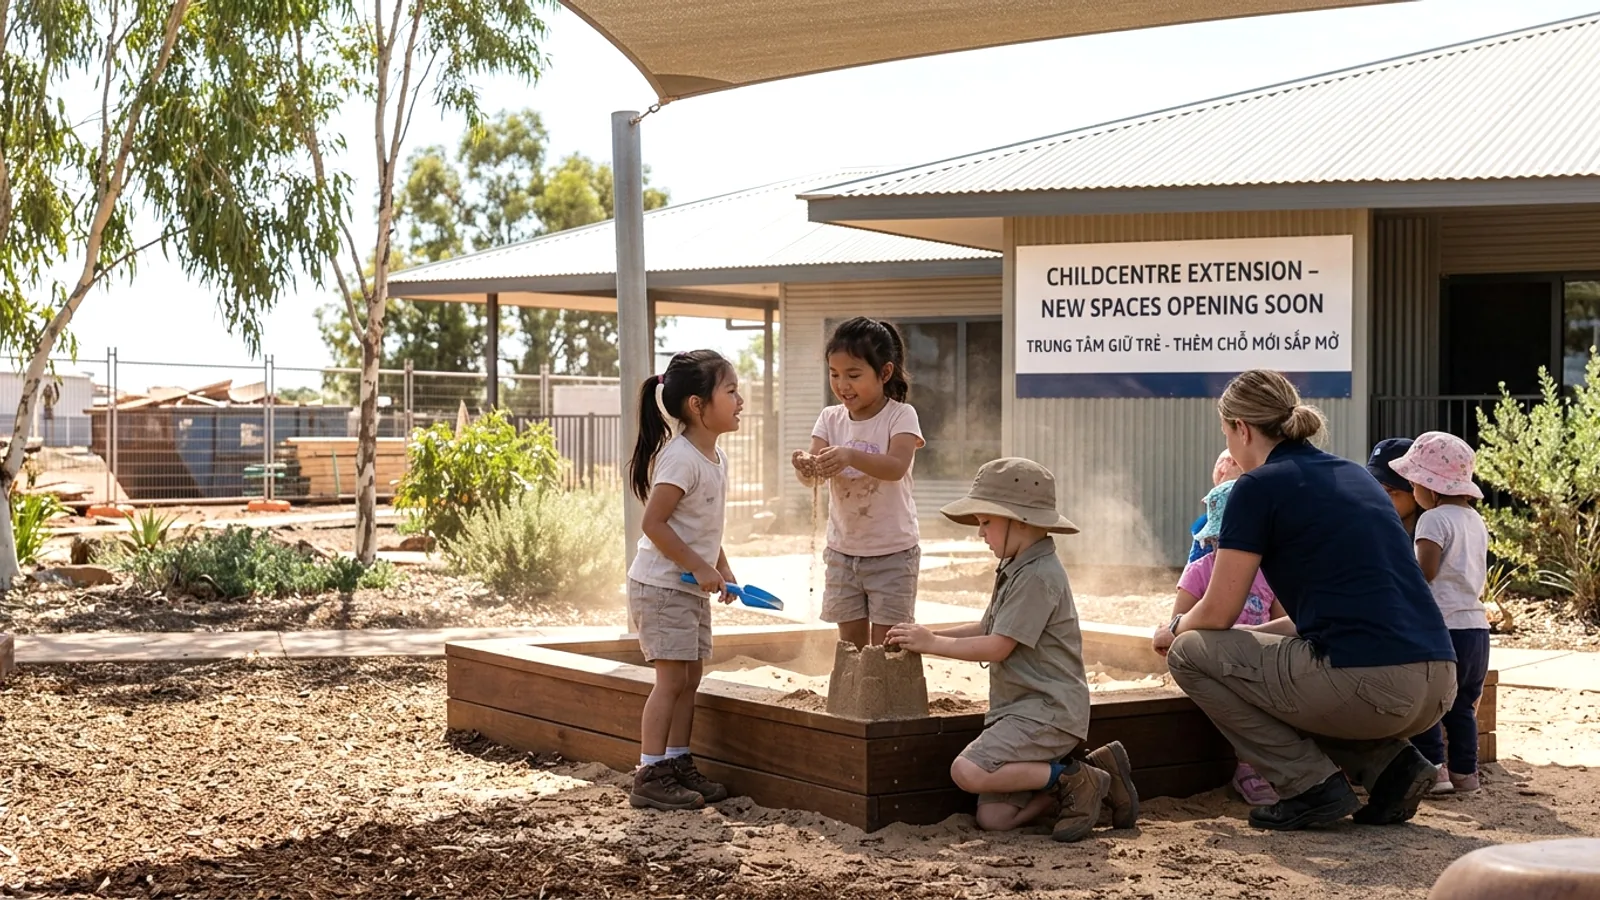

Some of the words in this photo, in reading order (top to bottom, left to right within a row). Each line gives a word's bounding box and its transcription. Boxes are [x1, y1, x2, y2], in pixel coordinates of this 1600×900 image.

[1046, 264, 1182, 286] CHILDCENTRE
[1188, 260, 1302, 283] EXTENSION
[1041, 299, 1085, 318] NEW
[1090, 296, 1162, 318] SPACES
[1167, 294, 1259, 316] OPENING
[1264, 293, 1324, 314] SOON
[1026, 339, 1072, 353] TRUNG
[1075, 335, 1105, 353] TÂM
[1108, 334, 1134, 353] GIỮ
[1173, 333, 1213, 351] THÊM
[1217, 330, 1249, 351] CHỖ
[1252, 332, 1280, 351] MỚI
